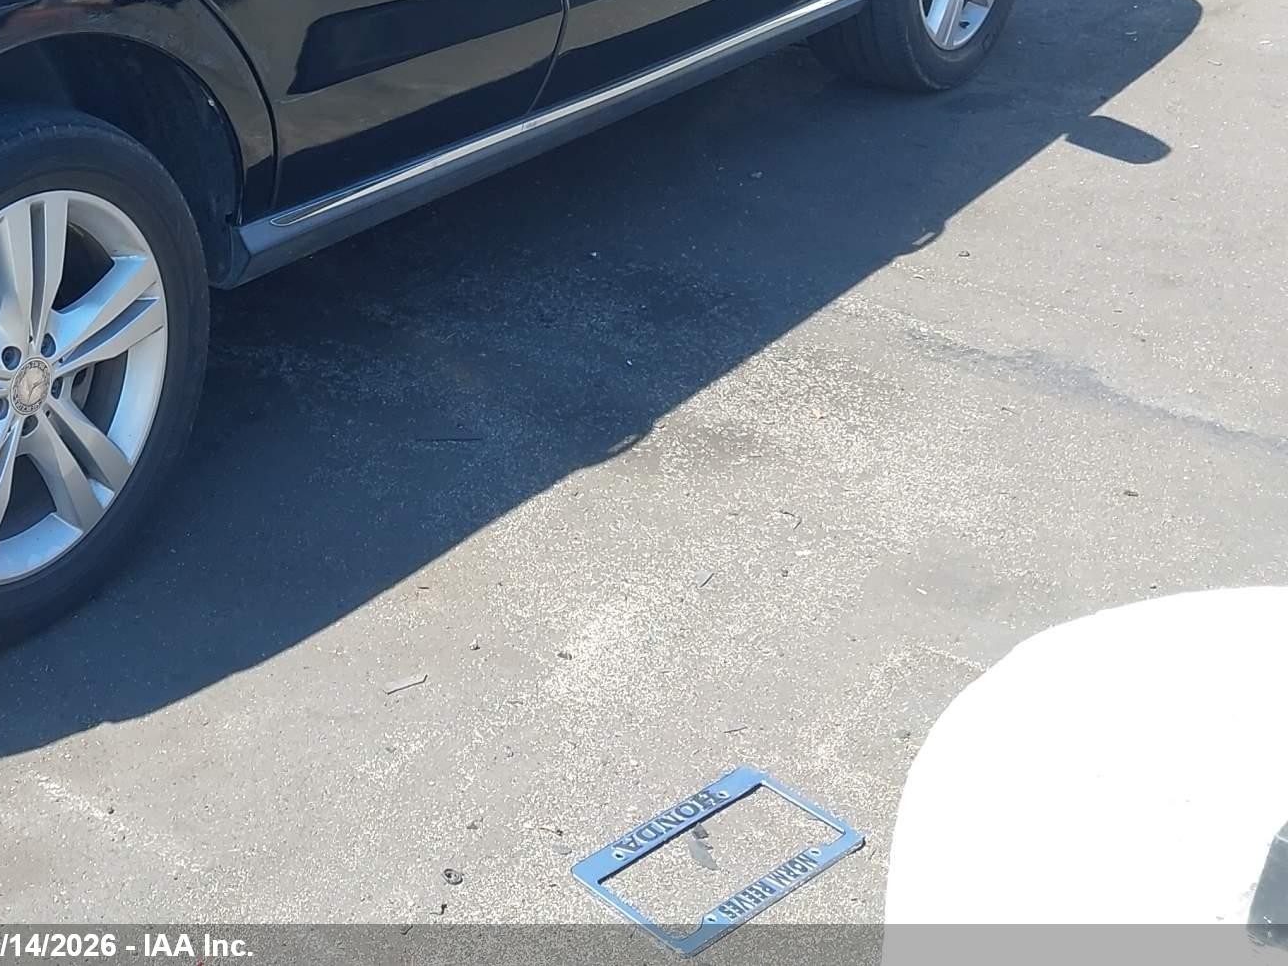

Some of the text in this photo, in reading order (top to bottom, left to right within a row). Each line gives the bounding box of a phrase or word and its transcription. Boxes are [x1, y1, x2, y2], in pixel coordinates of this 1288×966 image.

[612, 789, 728, 853] HONDA
[718, 853, 818, 920] NORM REEVES
